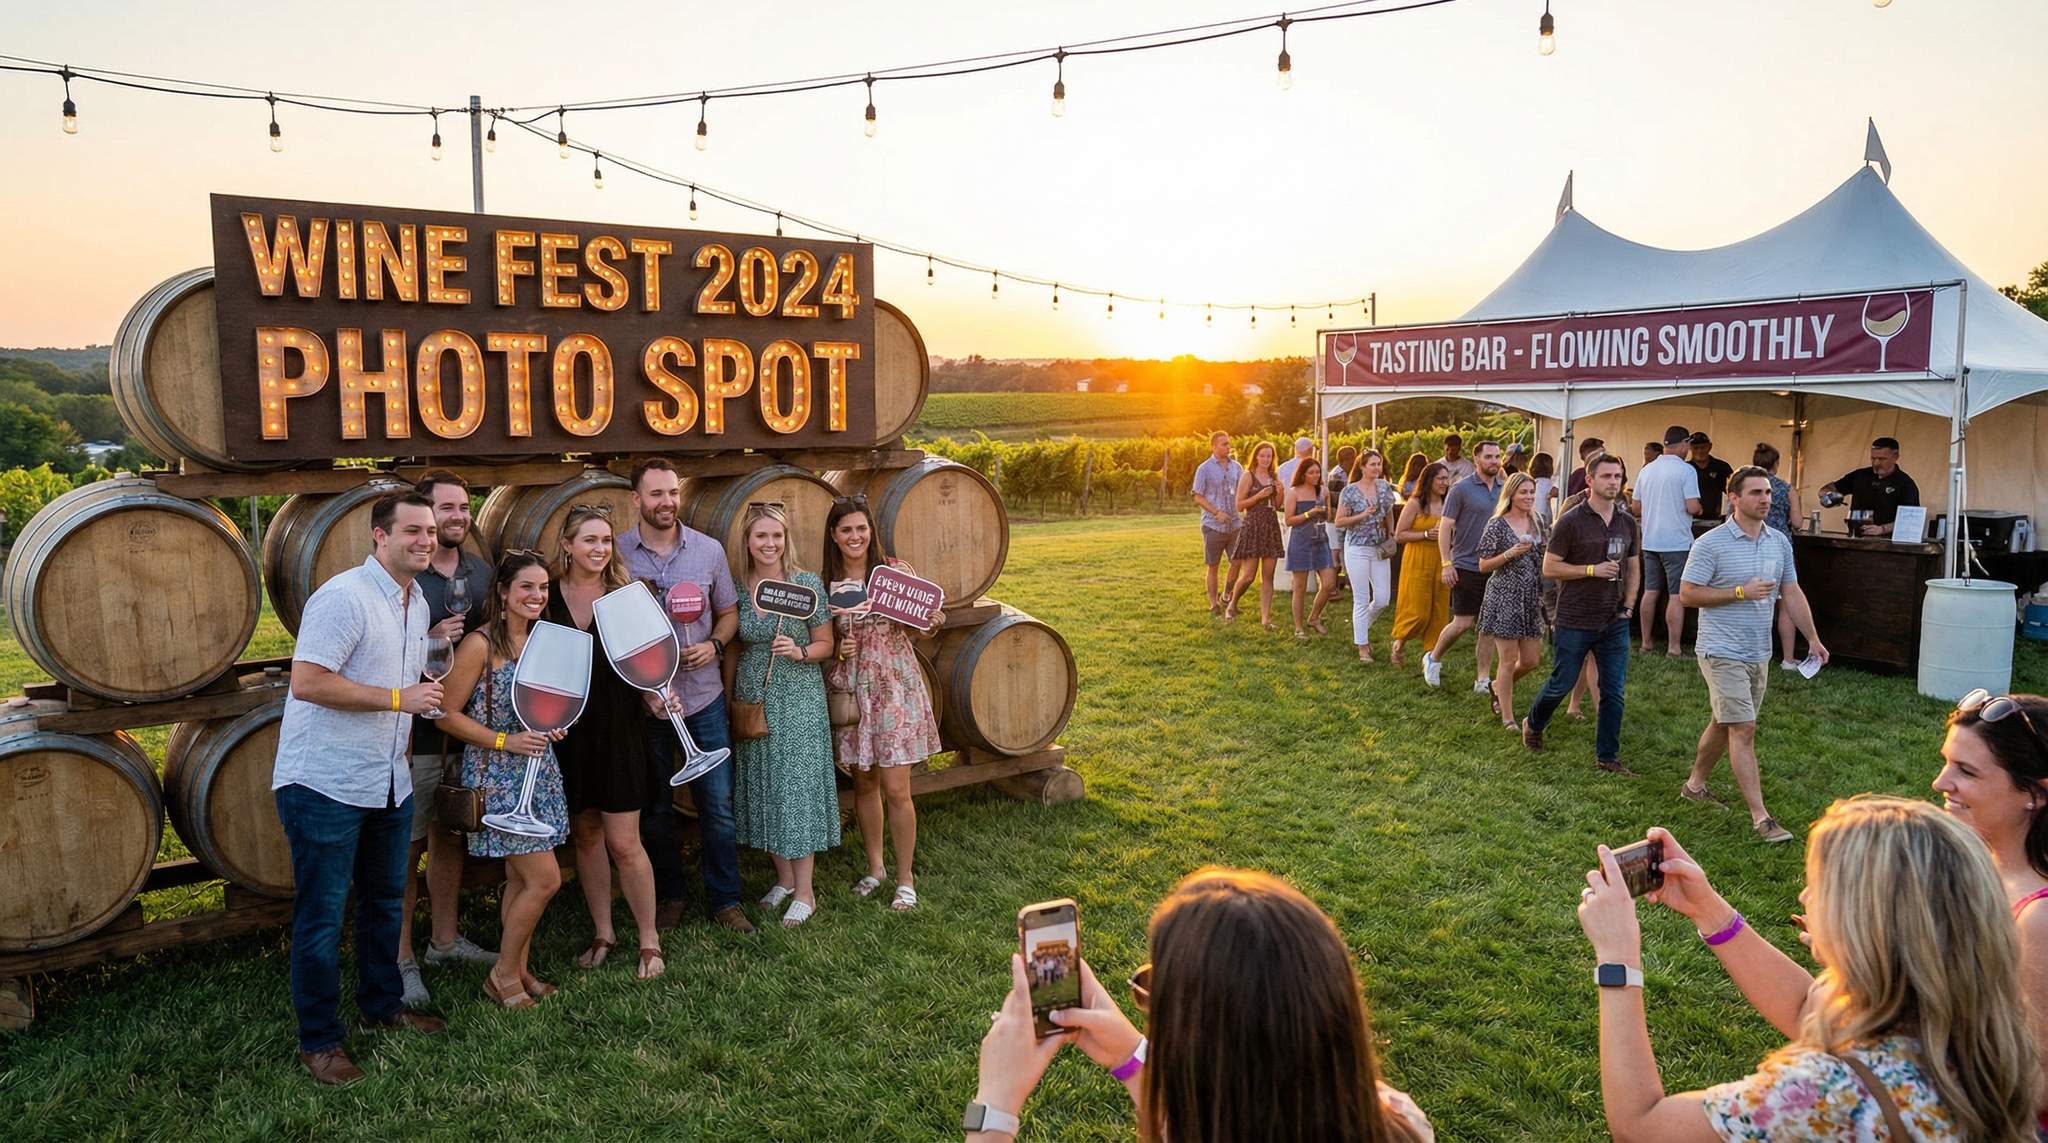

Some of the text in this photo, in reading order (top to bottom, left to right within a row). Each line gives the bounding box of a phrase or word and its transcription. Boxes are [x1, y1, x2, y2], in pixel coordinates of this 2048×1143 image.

[240, 211, 860, 320] WINE FEST 2024
[255, 326, 860, 441] PHOTO SPOT
[1369, 338, 1455, 374] TASTING
[1461, 335, 1506, 371] BAR
[1530, 326, 1650, 370] FLOWING
[1657, 313, 1836, 366] SMOOTHLY
